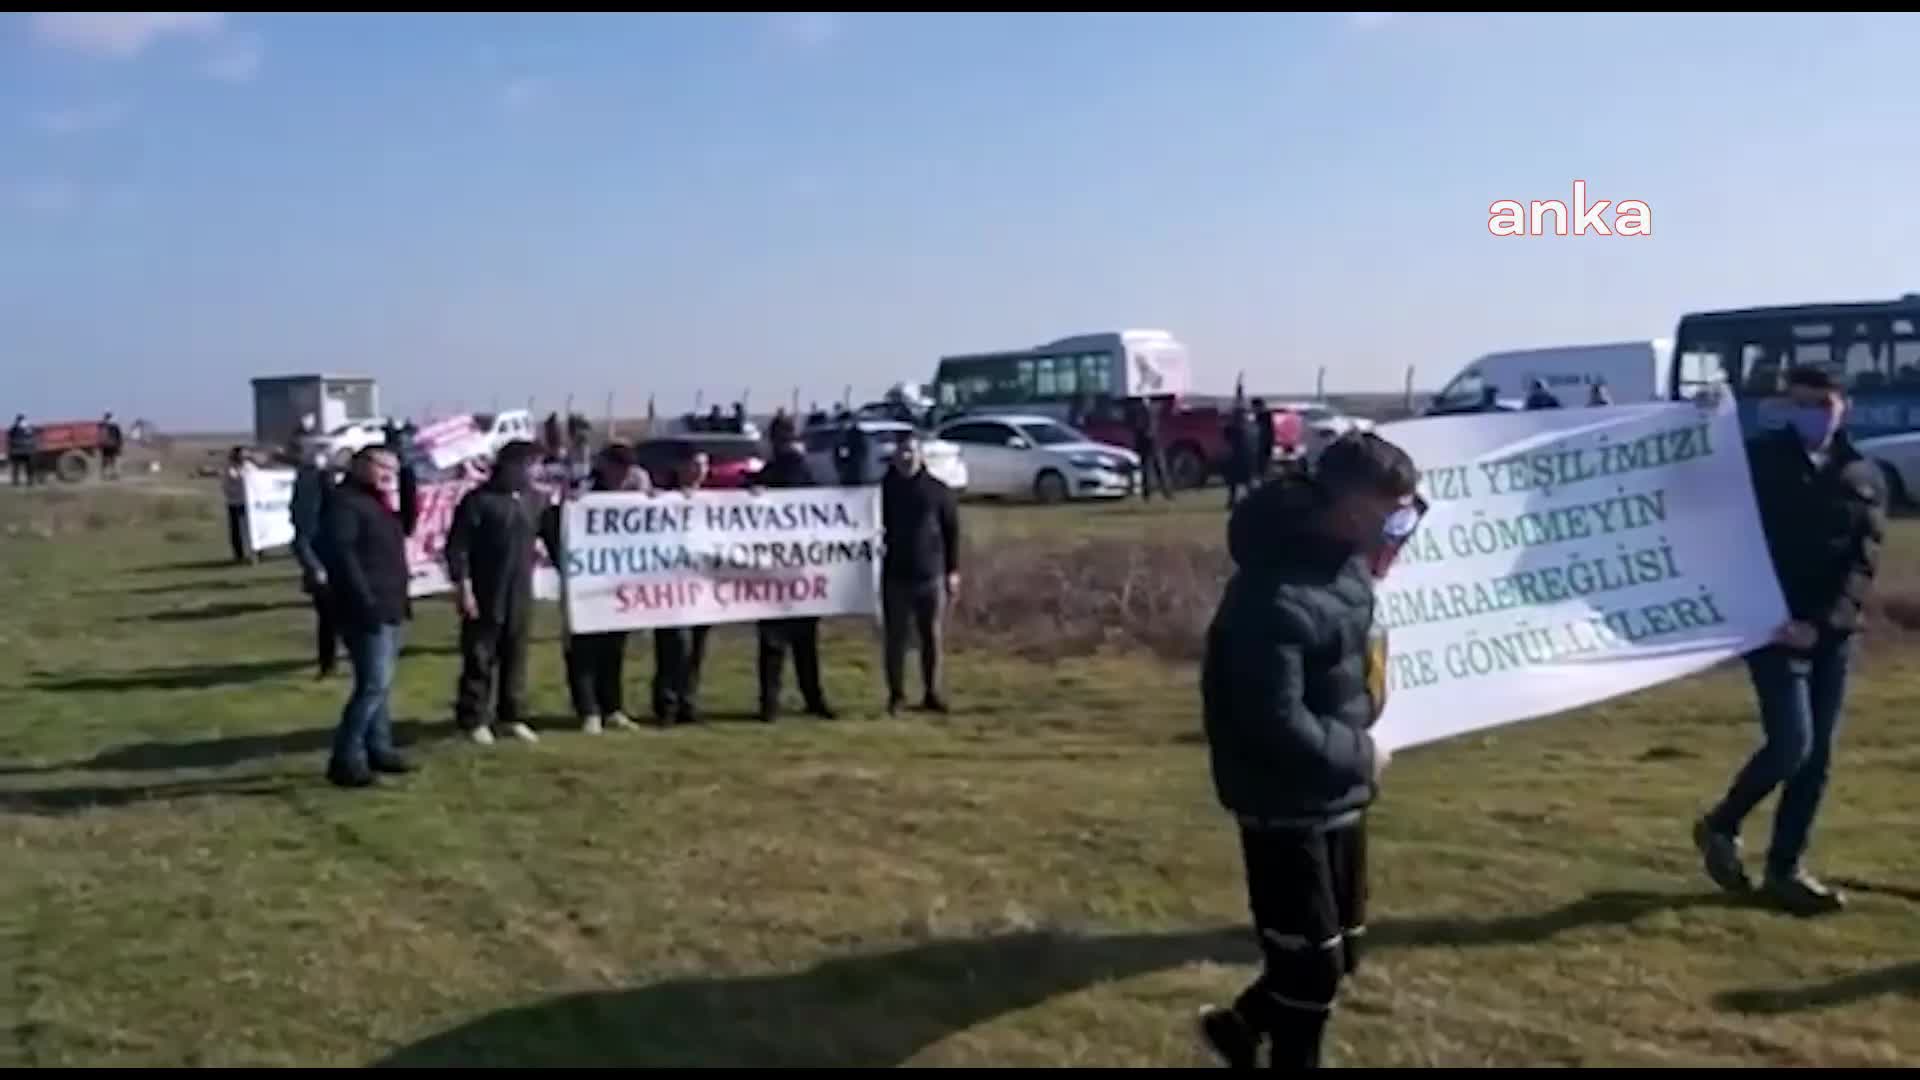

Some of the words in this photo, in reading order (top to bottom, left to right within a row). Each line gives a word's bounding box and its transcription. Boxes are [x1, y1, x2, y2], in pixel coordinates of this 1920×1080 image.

[1422, 465, 1471, 501] IZI
[586, 505, 693, 535] ERGENE
[1449, 486, 1665, 558] GÖMMEYİN
[713, 575, 828, 609] ÇIKIYOR
